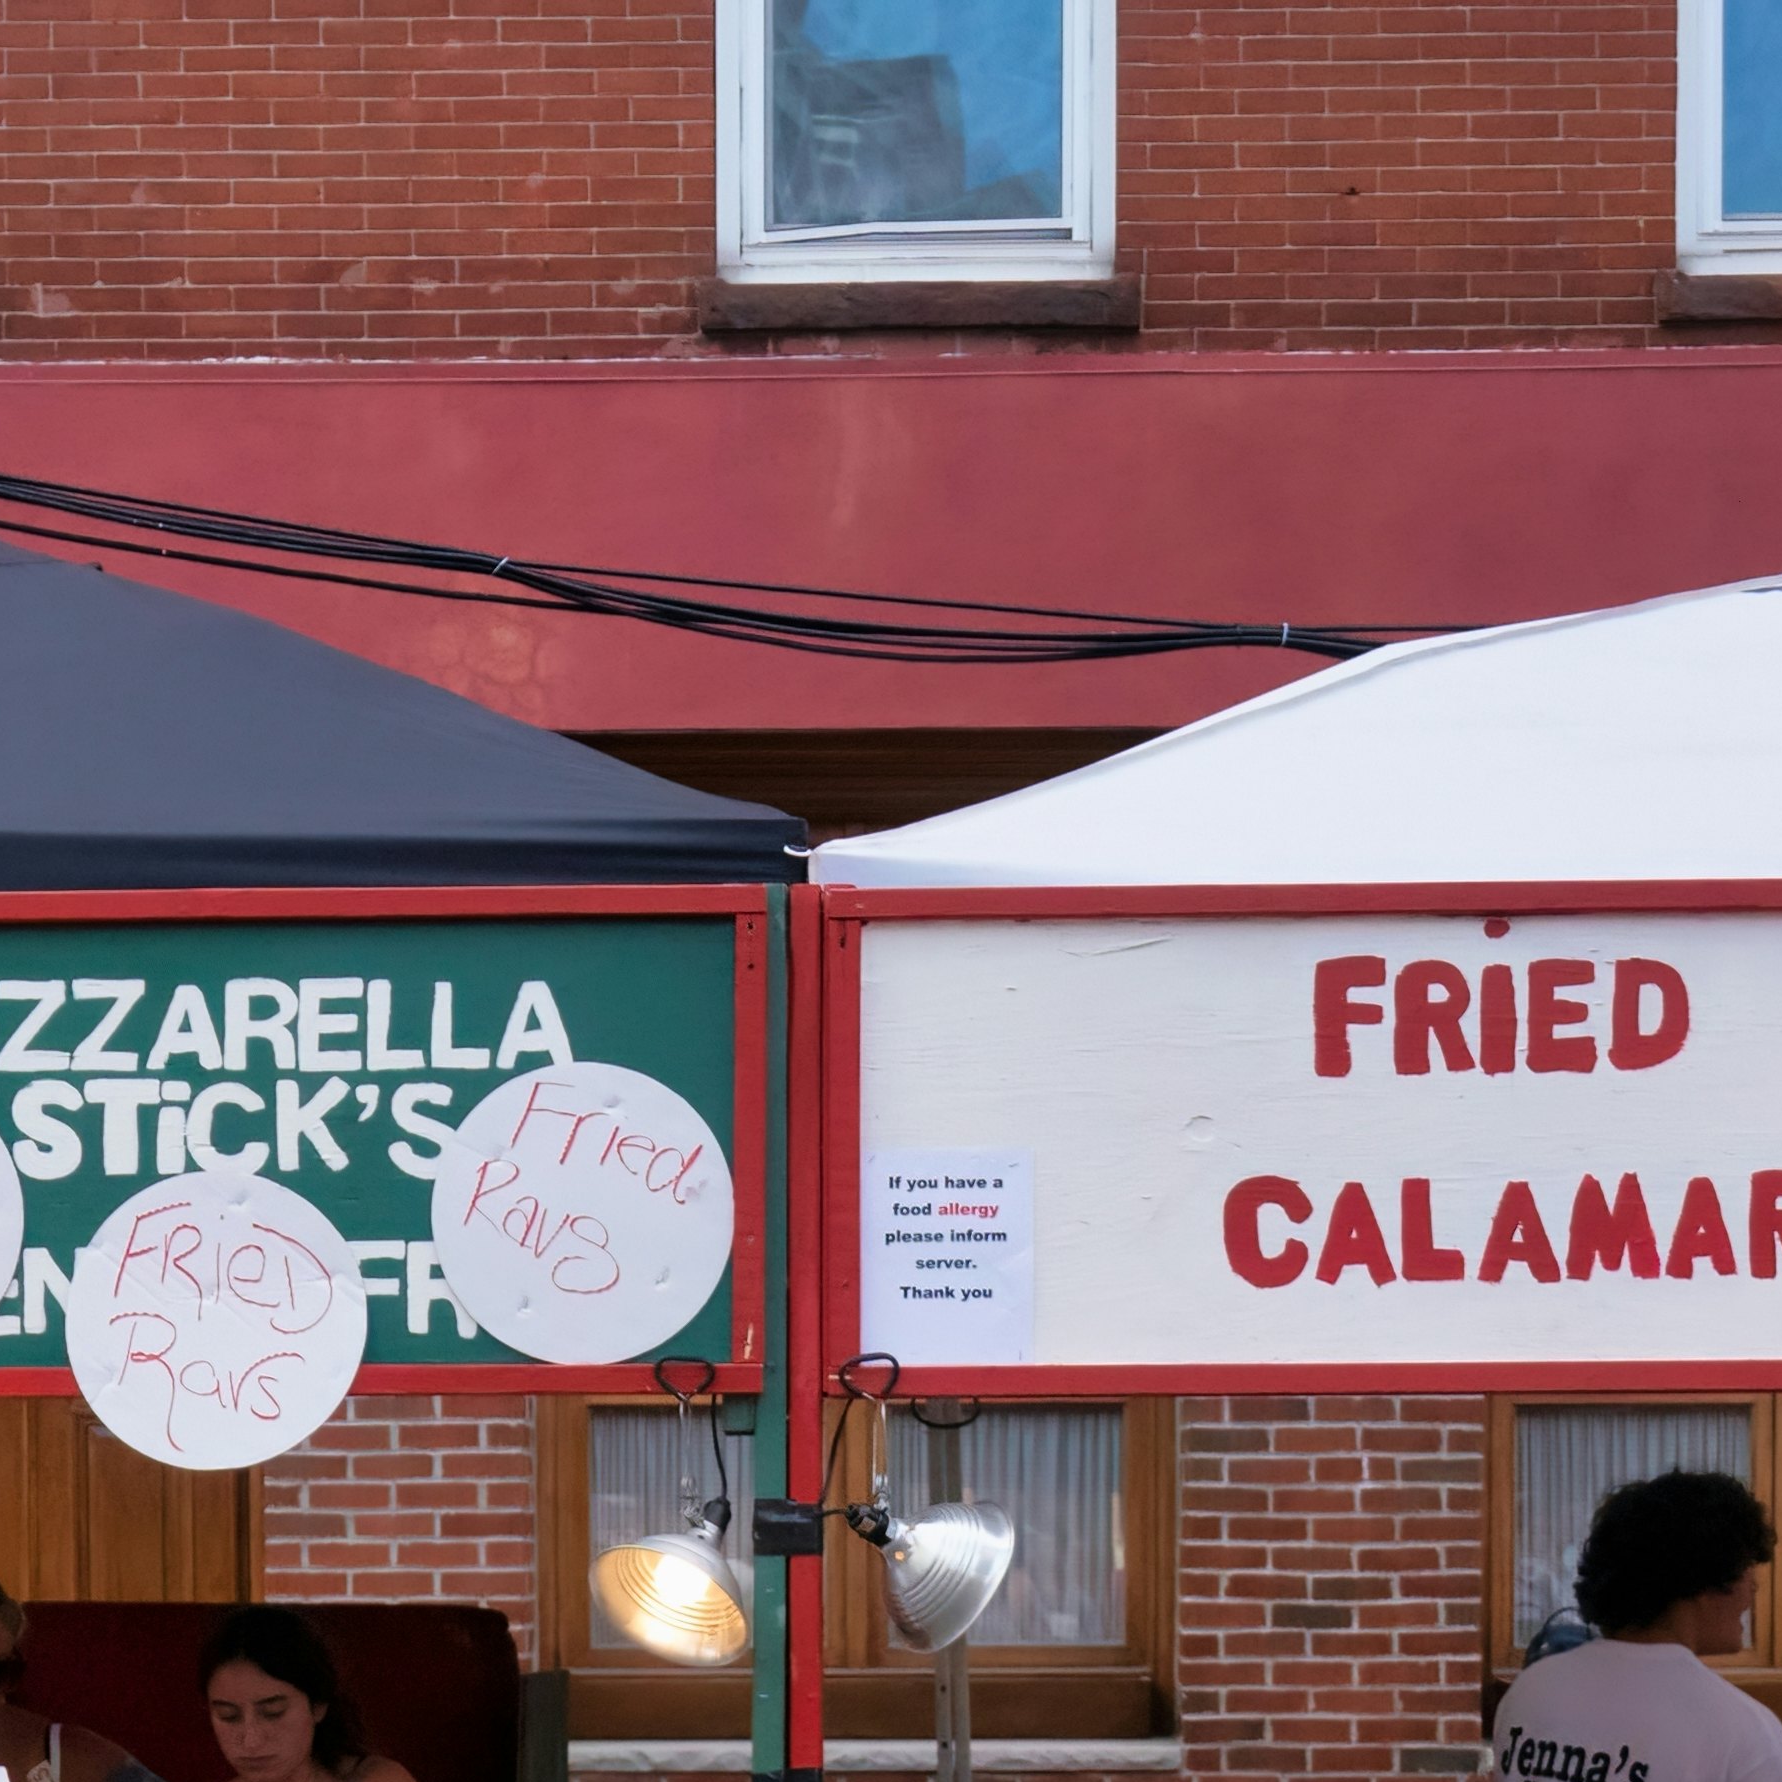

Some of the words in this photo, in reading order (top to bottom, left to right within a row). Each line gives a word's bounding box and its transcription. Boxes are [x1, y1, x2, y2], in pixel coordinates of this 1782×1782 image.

[511, 1081, 703, 1205] Fried
[888, 1176, 901, 1190] If
[906, 1179, 938, 1192] you
[944, 1176, 987, 1189] have
[992, 1179, 1003, 1189] a
[893, 1203, 932, 1216] food
[938, 1203, 999, 1218] allergy
[885, 1230, 944, 1245] please
[950, 1229, 1007, 1243] inform
[915, 1258, 977, 1269] server.
[900, 1286, 955, 1299] Thank
[960, 1289, 992, 1302] you
